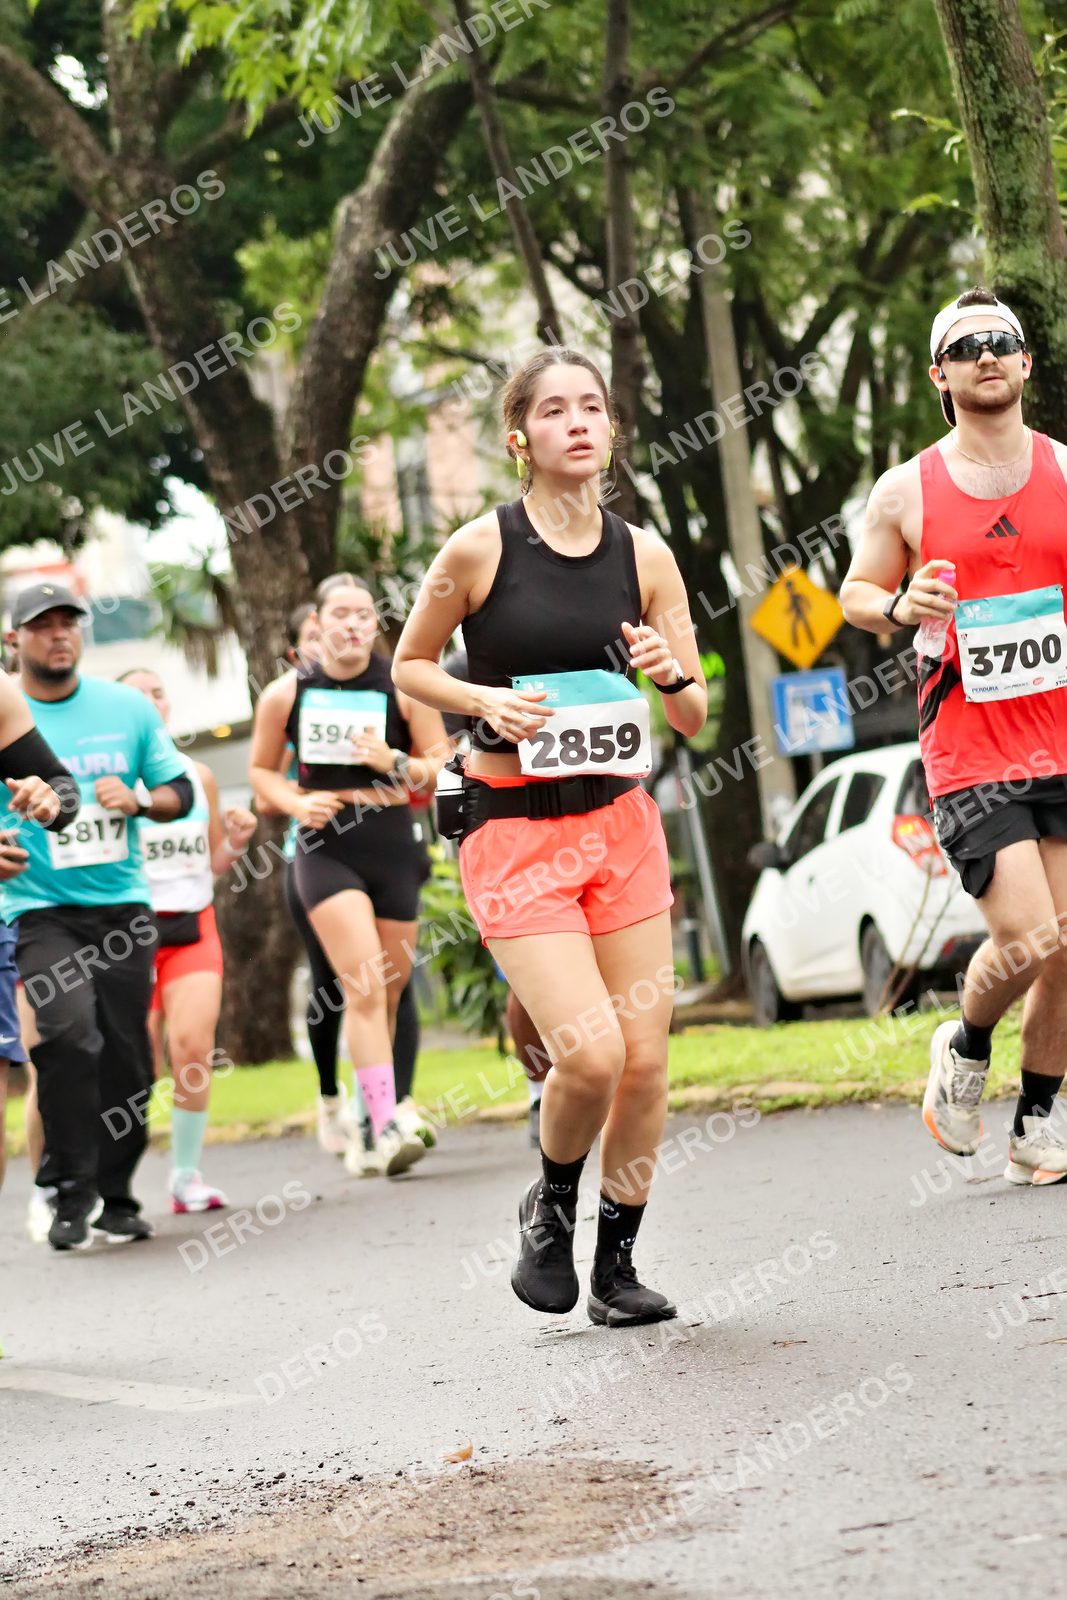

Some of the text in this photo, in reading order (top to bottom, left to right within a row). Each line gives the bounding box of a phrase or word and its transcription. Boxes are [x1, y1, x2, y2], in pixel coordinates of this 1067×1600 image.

[967, 633, 1062, 678] 3700
[526, 722, 641, 769] 2859
[57, 817, 125, 846] 5817
[145, 836, 207, 861] 3940
